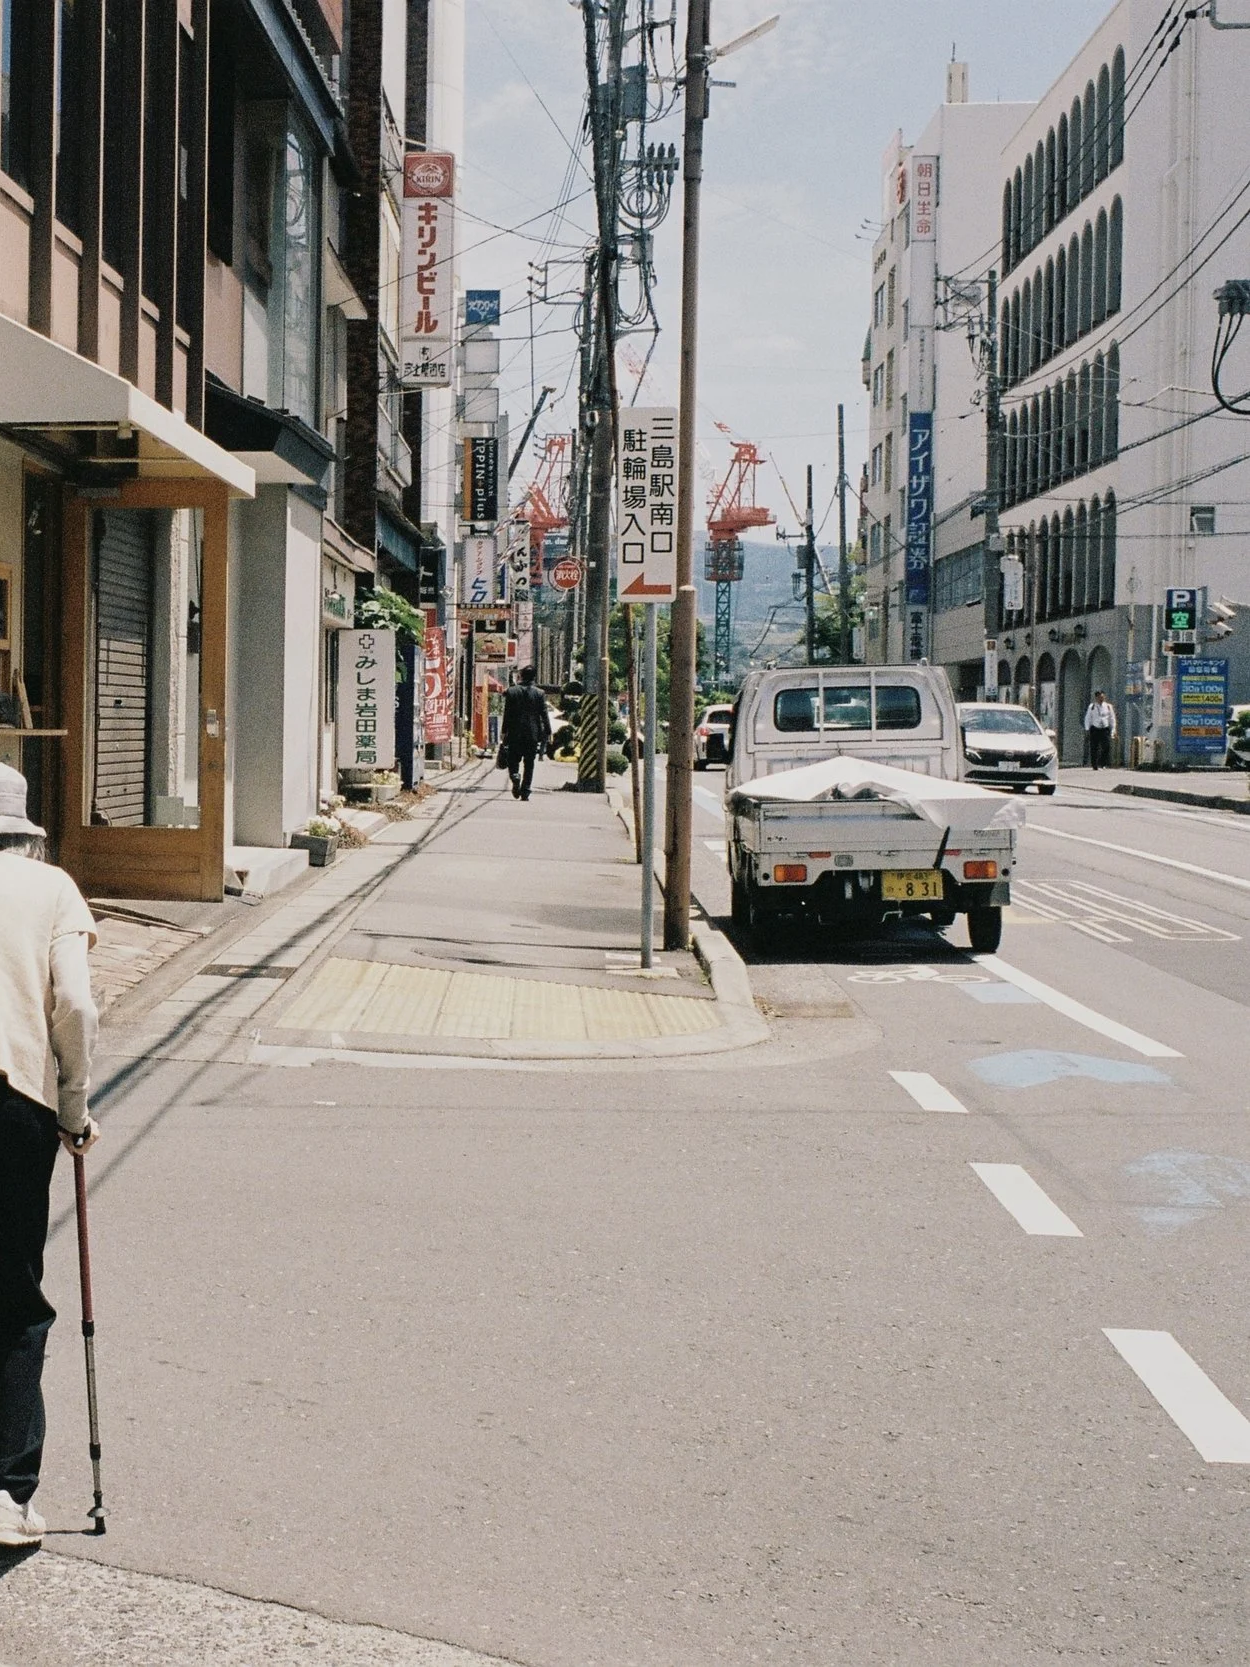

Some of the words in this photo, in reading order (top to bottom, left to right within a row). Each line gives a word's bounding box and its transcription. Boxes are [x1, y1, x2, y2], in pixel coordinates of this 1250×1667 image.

[416, 175, 441, 183] KIRIN
[916, 163, 932, 234] 朝日生命
[415, 202, 438, 334] キリンビール
[475, 439, 486, 480] IPPIN
[475, 488, 486, 519] plus
[621, 428, 648, 564] 駐輪場入口
[649, 417, 675, 553] 三島駅南口
[907, 429, 930, 570] アイザワ証券
[470, 577, 488, 603] ヒロ
[555, 569, 579, 580] 消火栓
[1172, 590, 1191, 608] P
[1171, 611, 1190, 629] 空
[355, 655, 378, 765] みしま岩田薬局
